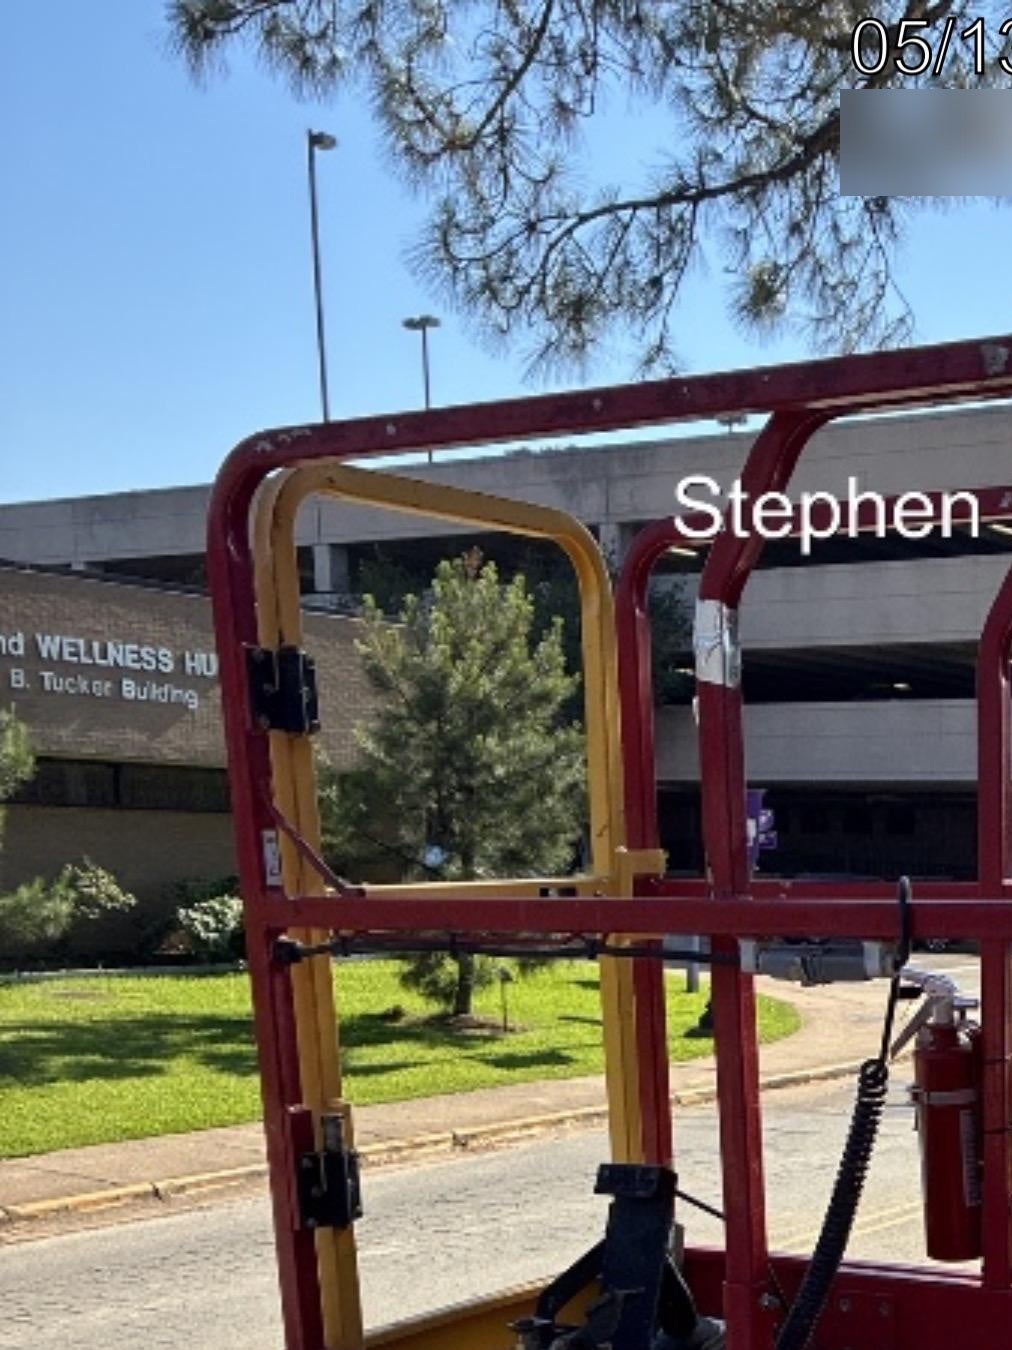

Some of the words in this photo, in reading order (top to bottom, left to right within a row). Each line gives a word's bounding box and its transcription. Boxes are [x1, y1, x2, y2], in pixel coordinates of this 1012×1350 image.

[36, 633, 174, 673] WELLNESS
[185, 651, 218, 676] HU
[40, 671, 112, 698] Tucker
[121, 680, 199, 708] Building
